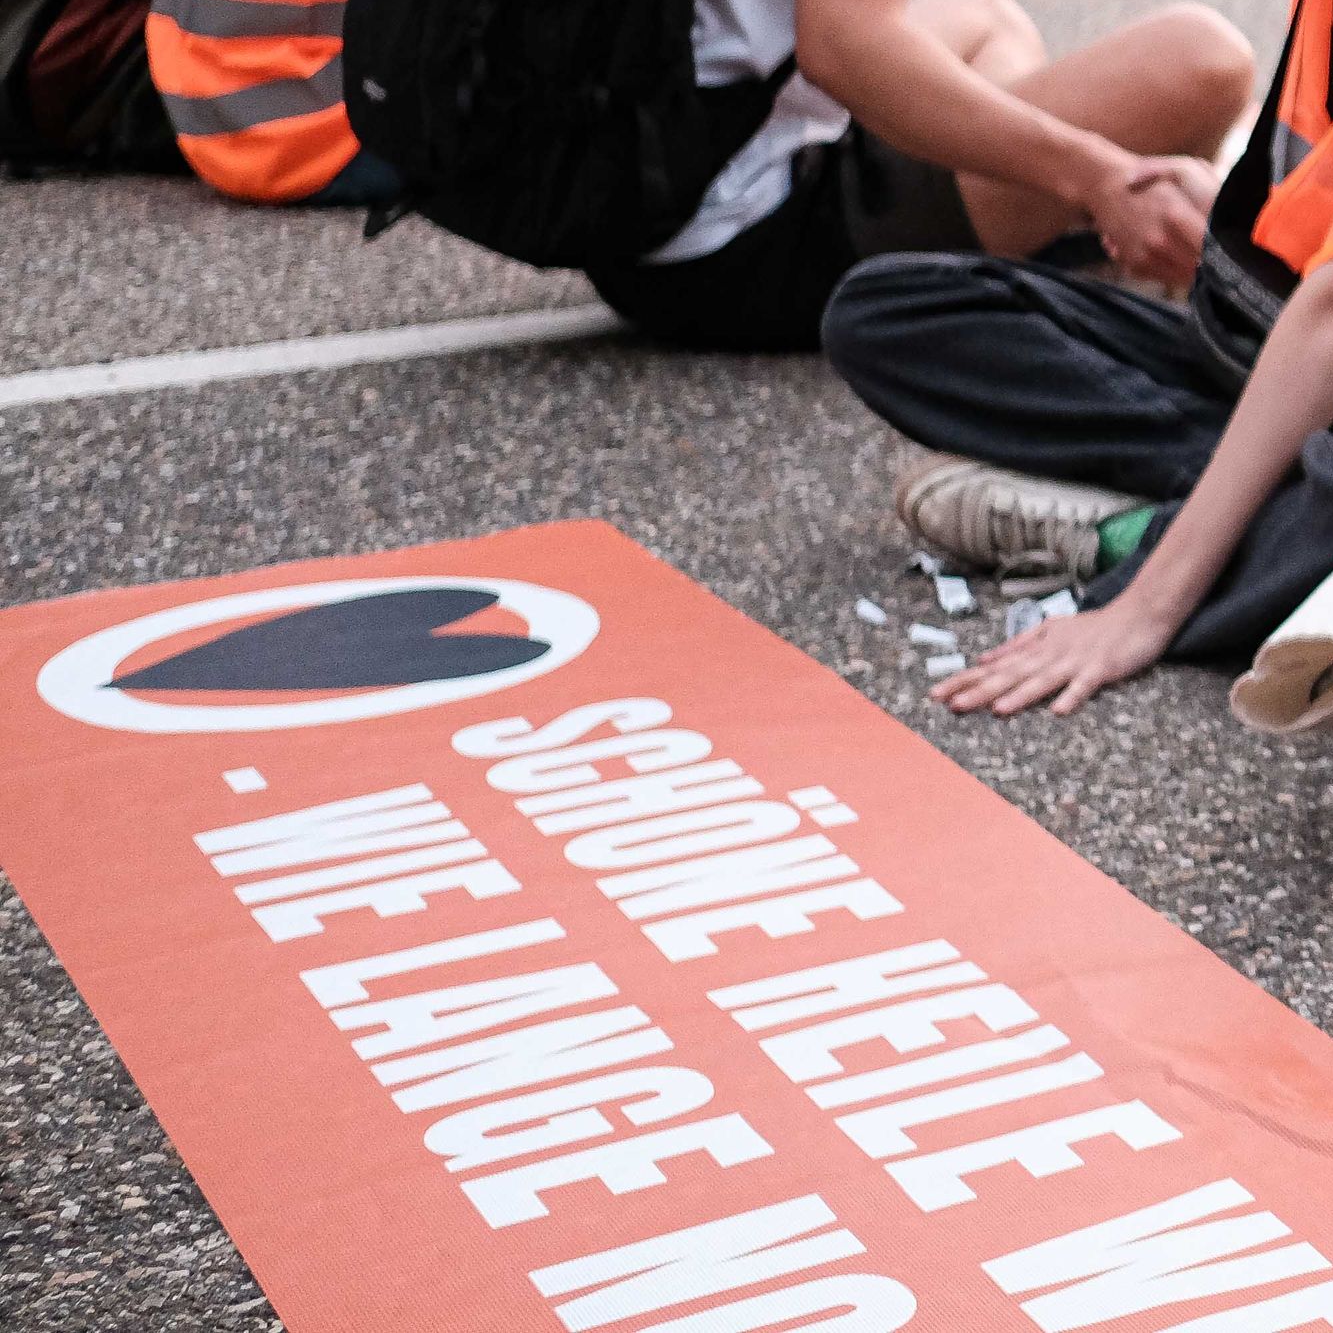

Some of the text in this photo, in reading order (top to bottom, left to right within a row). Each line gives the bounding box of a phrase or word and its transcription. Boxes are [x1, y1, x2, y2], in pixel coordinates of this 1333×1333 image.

[193, 781, 522, 943] WIE
[450, 696, 905, 963] SCHÖNE
[706, 938, 1184, 1213] HEILE
[299, 916, 775, 1230] LANGE
